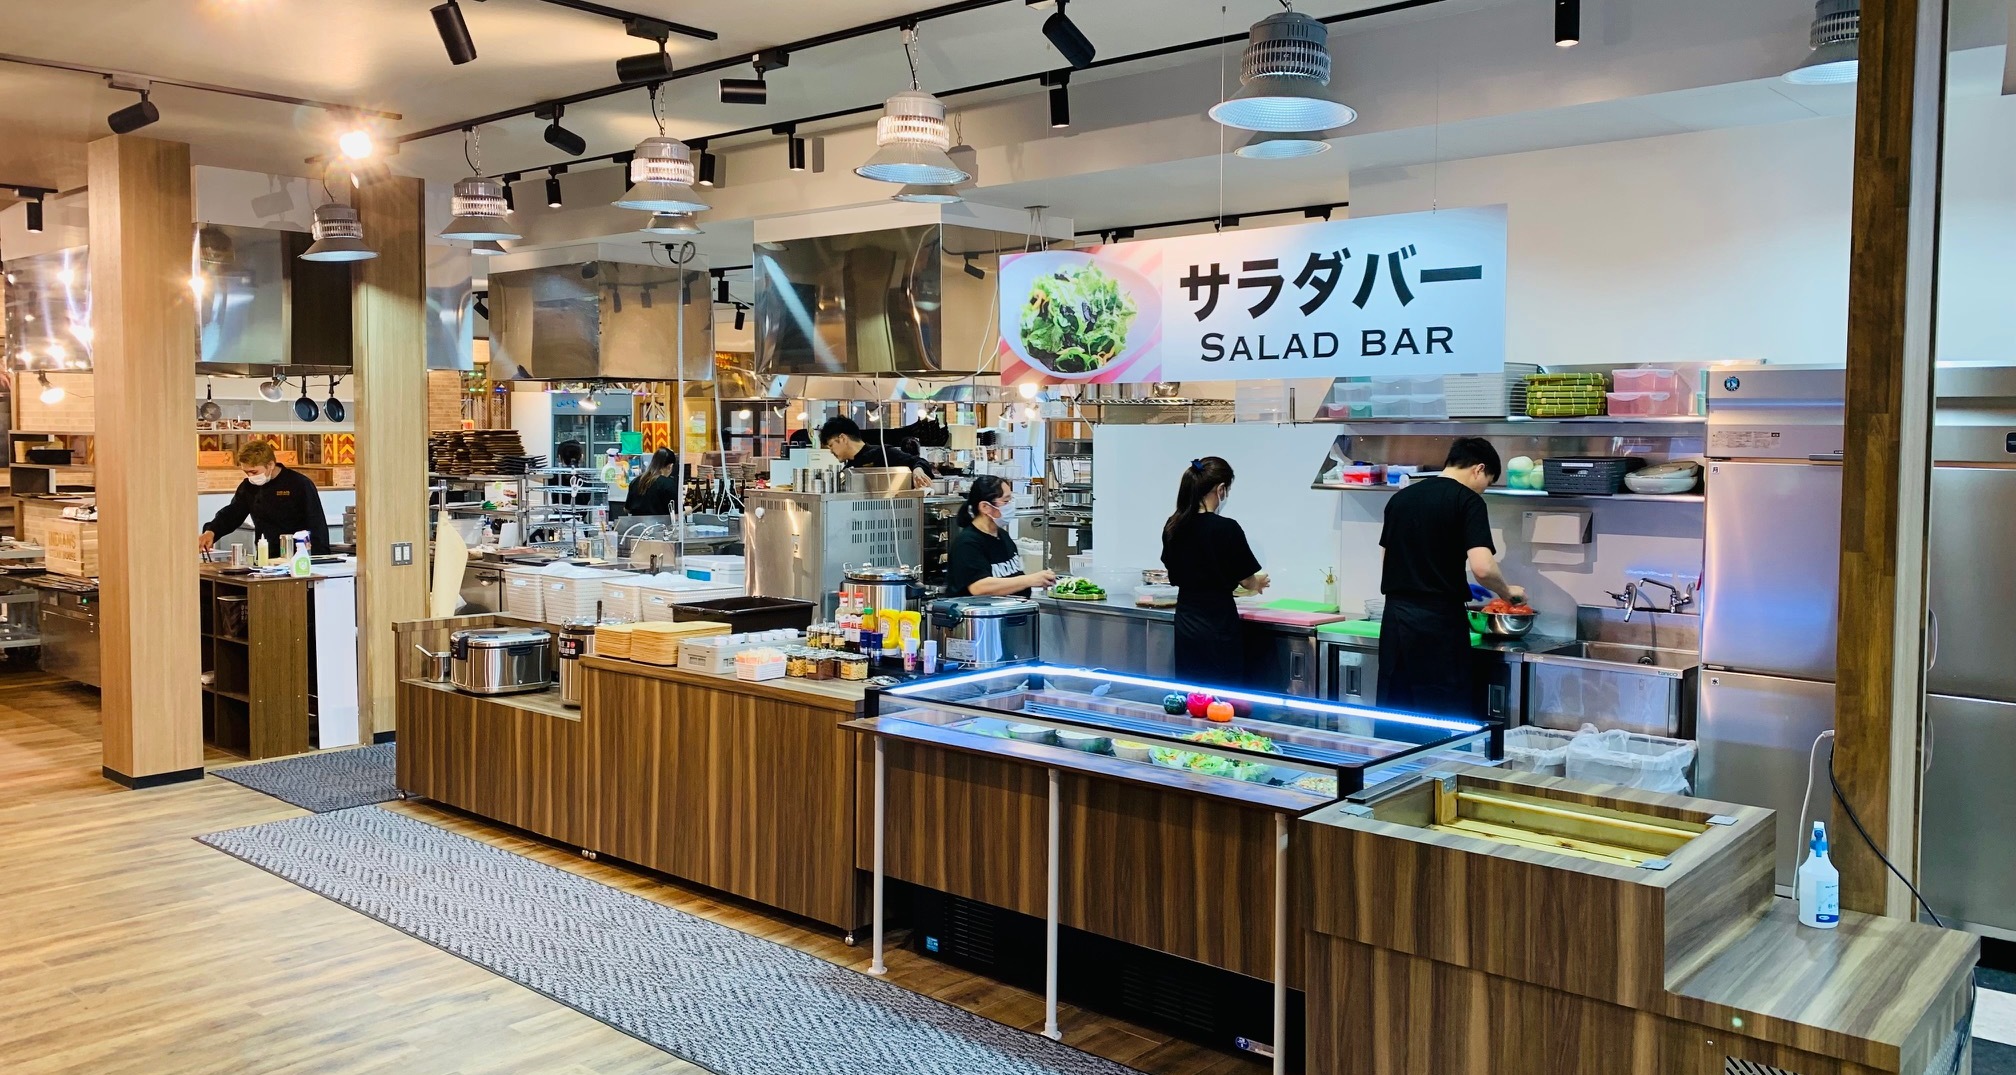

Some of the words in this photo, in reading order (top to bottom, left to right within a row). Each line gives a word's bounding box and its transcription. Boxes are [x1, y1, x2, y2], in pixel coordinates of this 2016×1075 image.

[1180, 243, 1482, 322] サラダバー
[1201, 332, 1339, 362] SALAD
[1361, 326, 1454, 357] BAR
